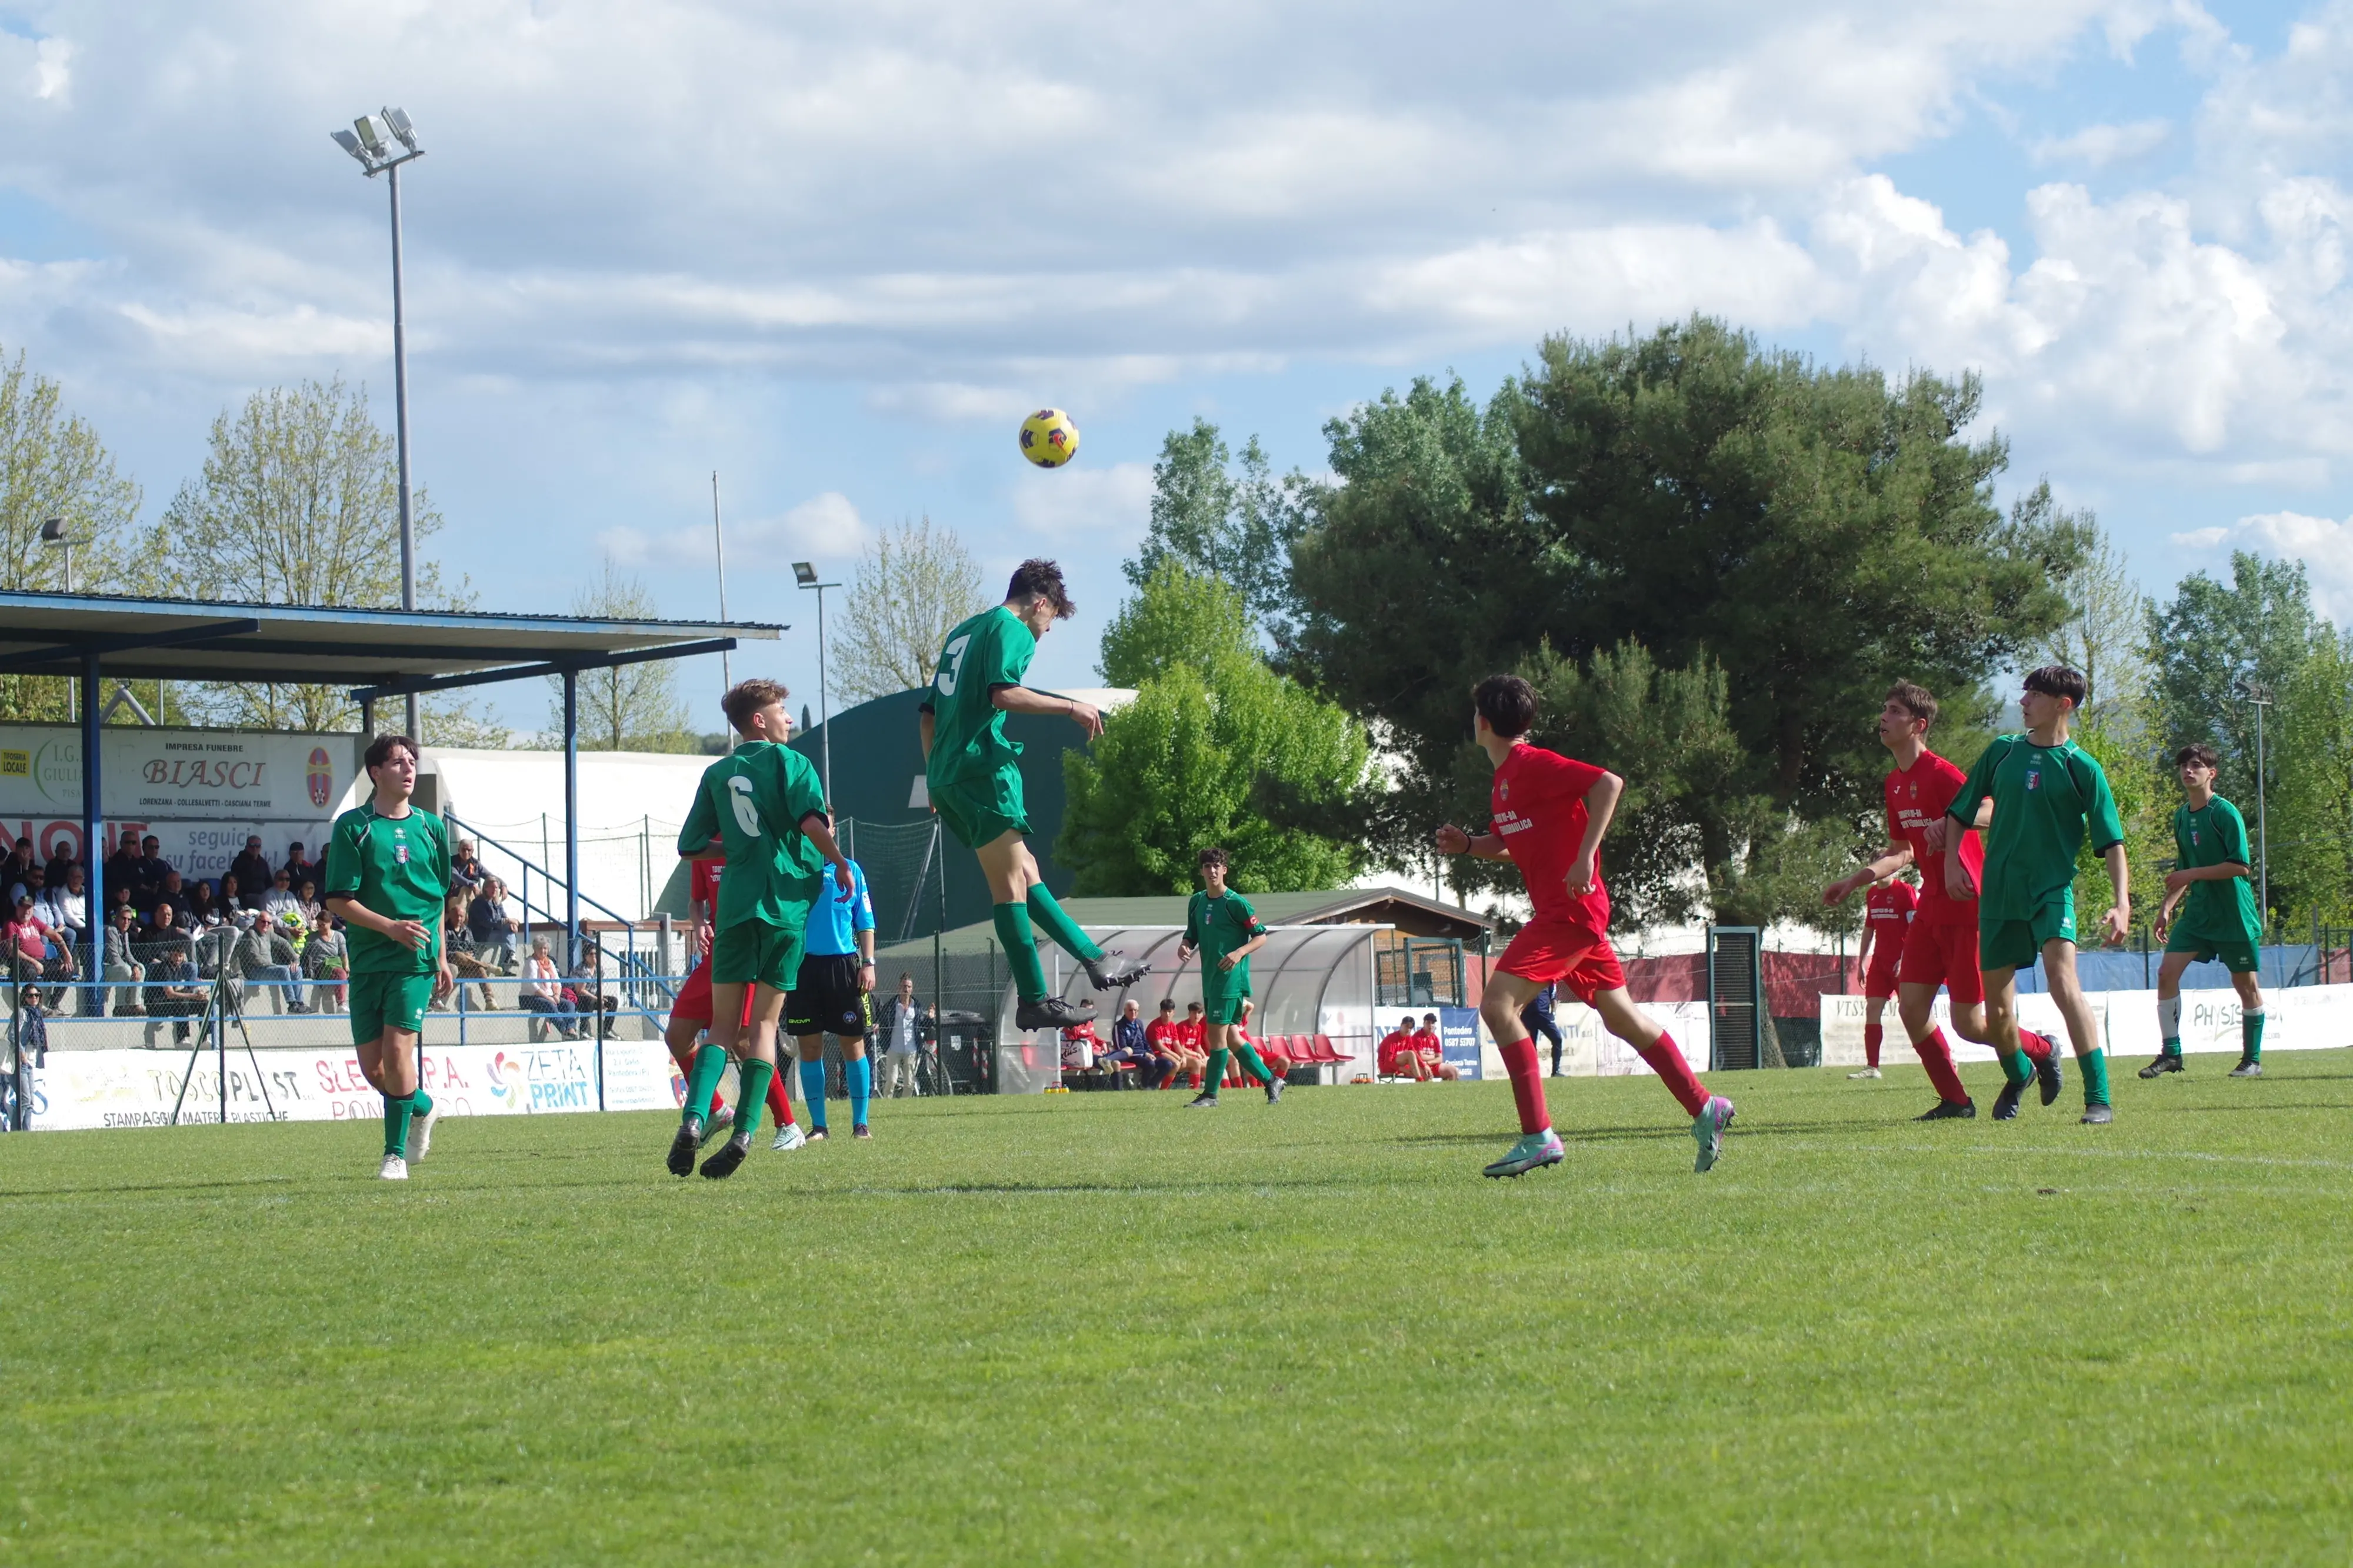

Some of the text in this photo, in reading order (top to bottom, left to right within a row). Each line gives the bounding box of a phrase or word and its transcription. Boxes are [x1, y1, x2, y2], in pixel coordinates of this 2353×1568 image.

[938, 634, 971, 696] 3
[4, 752, 26, 761] TIFOSERIA
[165, 743, 204, 751] IMPRESA
[4, 763, 26, 774] LOCALE
[143, 759, 266, 789] BIASCI
[139, 798, 173, 806] LORENZANA
[177, 799, 221, 807] COLLESALVETTI
[728, 776, 762, 837] 6
[520, 1049, 586, 1081] ZETA
[530, 1081, 587, 1109] PRINT
